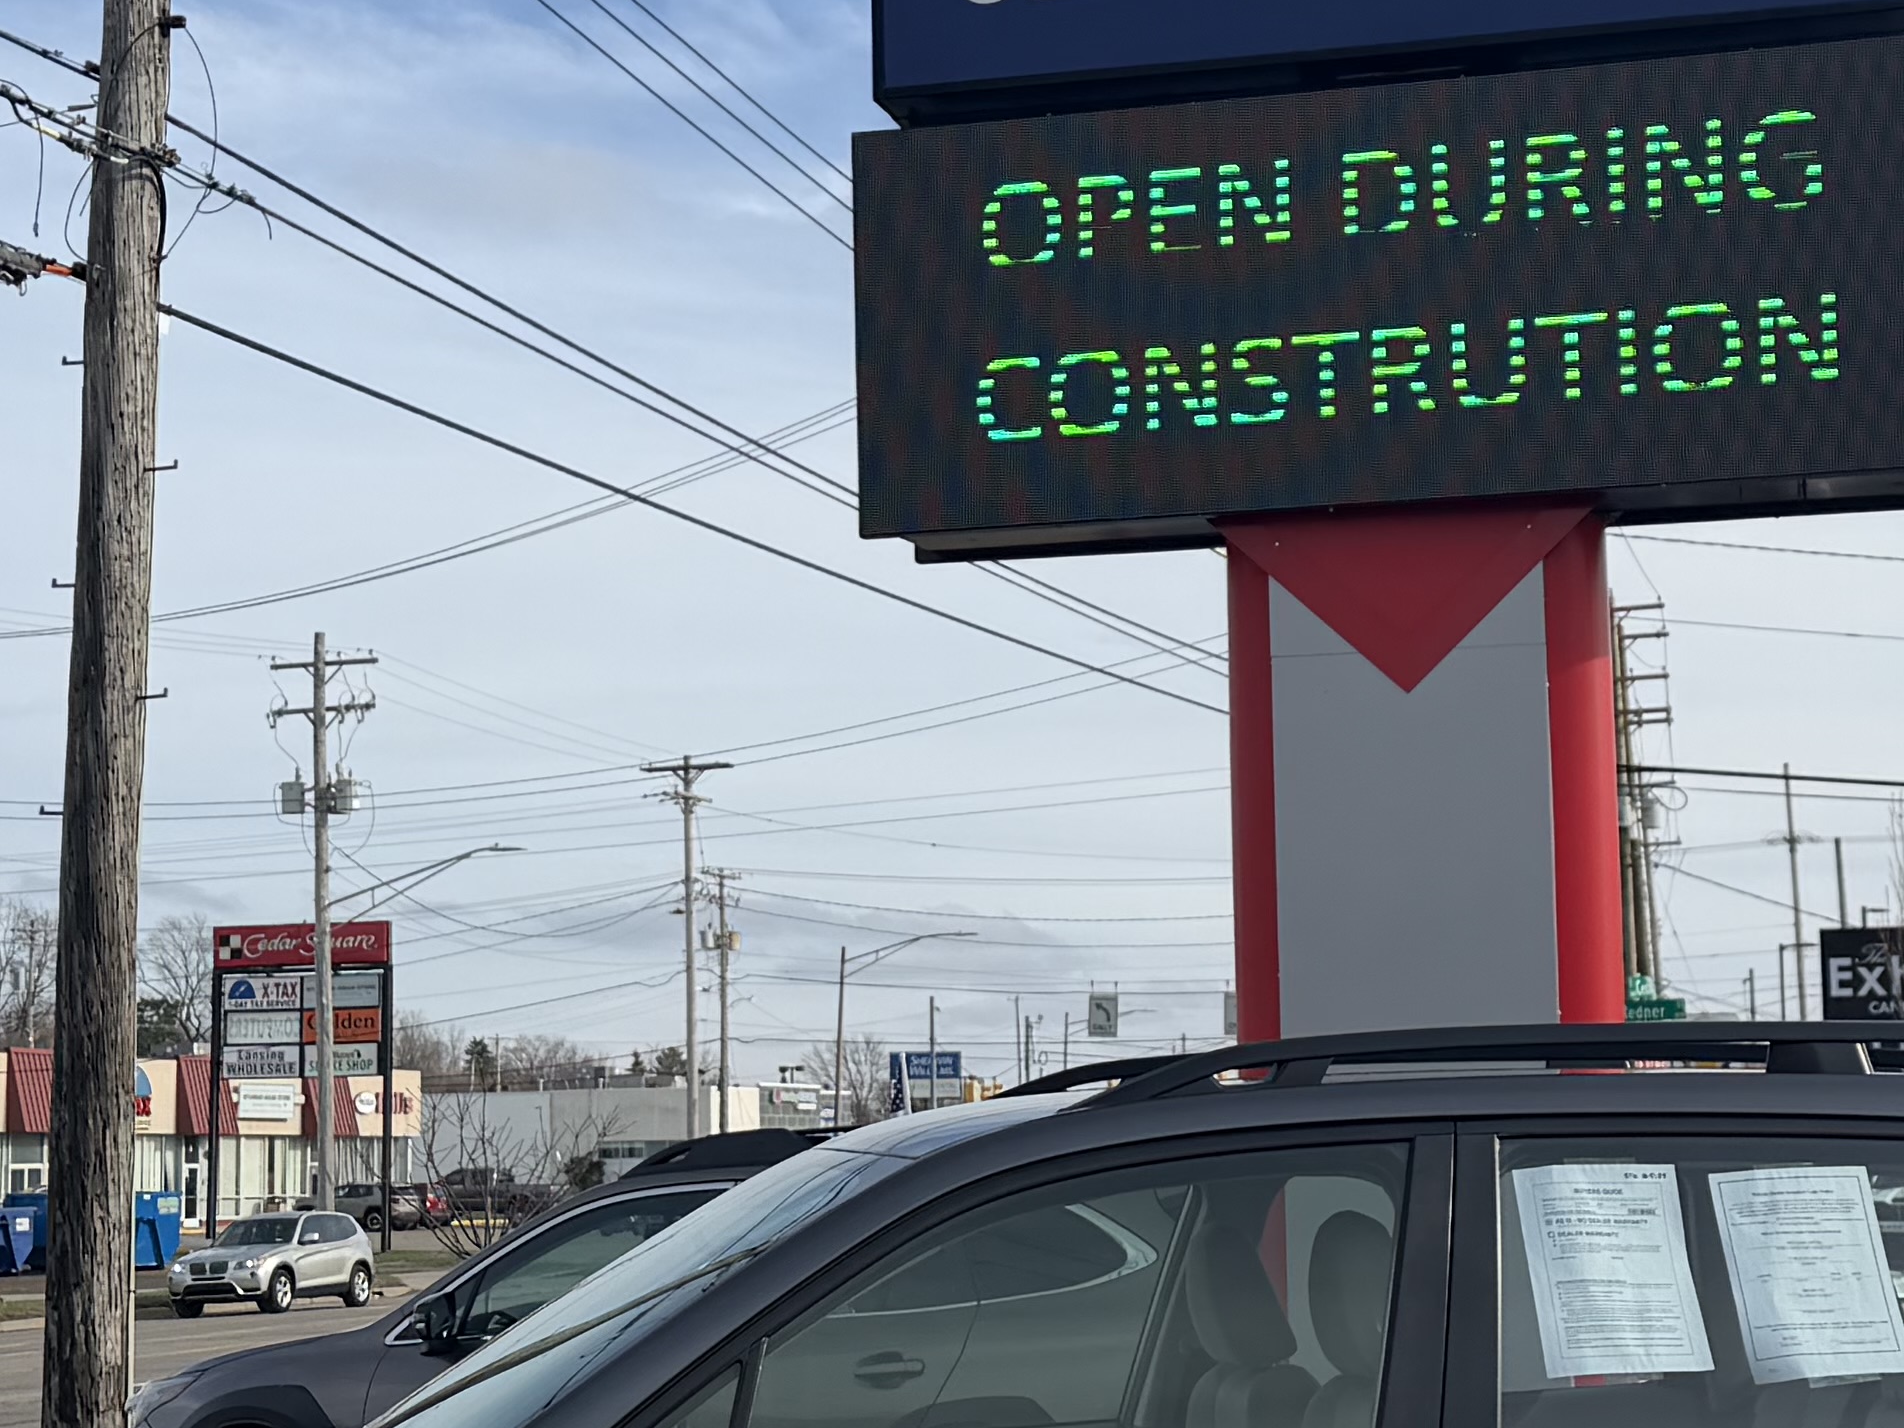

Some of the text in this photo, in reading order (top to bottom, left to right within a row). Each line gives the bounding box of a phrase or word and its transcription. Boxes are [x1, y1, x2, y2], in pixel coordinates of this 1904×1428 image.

[981, 109, 1825, 268] OPEN DURING
[976, 290, 1844, 443] CONSTRUTION
[243, 931, 301, 958] Cedar
[261, 980, 298, 1000] X-TAX
[266, 999, 296, 1007] SERVICE
[306, 1011, 375, 1030] Glden
[237, 1048, 286, 1063] Lansing
[224, 1060, 297, 1076] WHOLESALE
[308, 1059, 374, 1072] SKE SHOP
